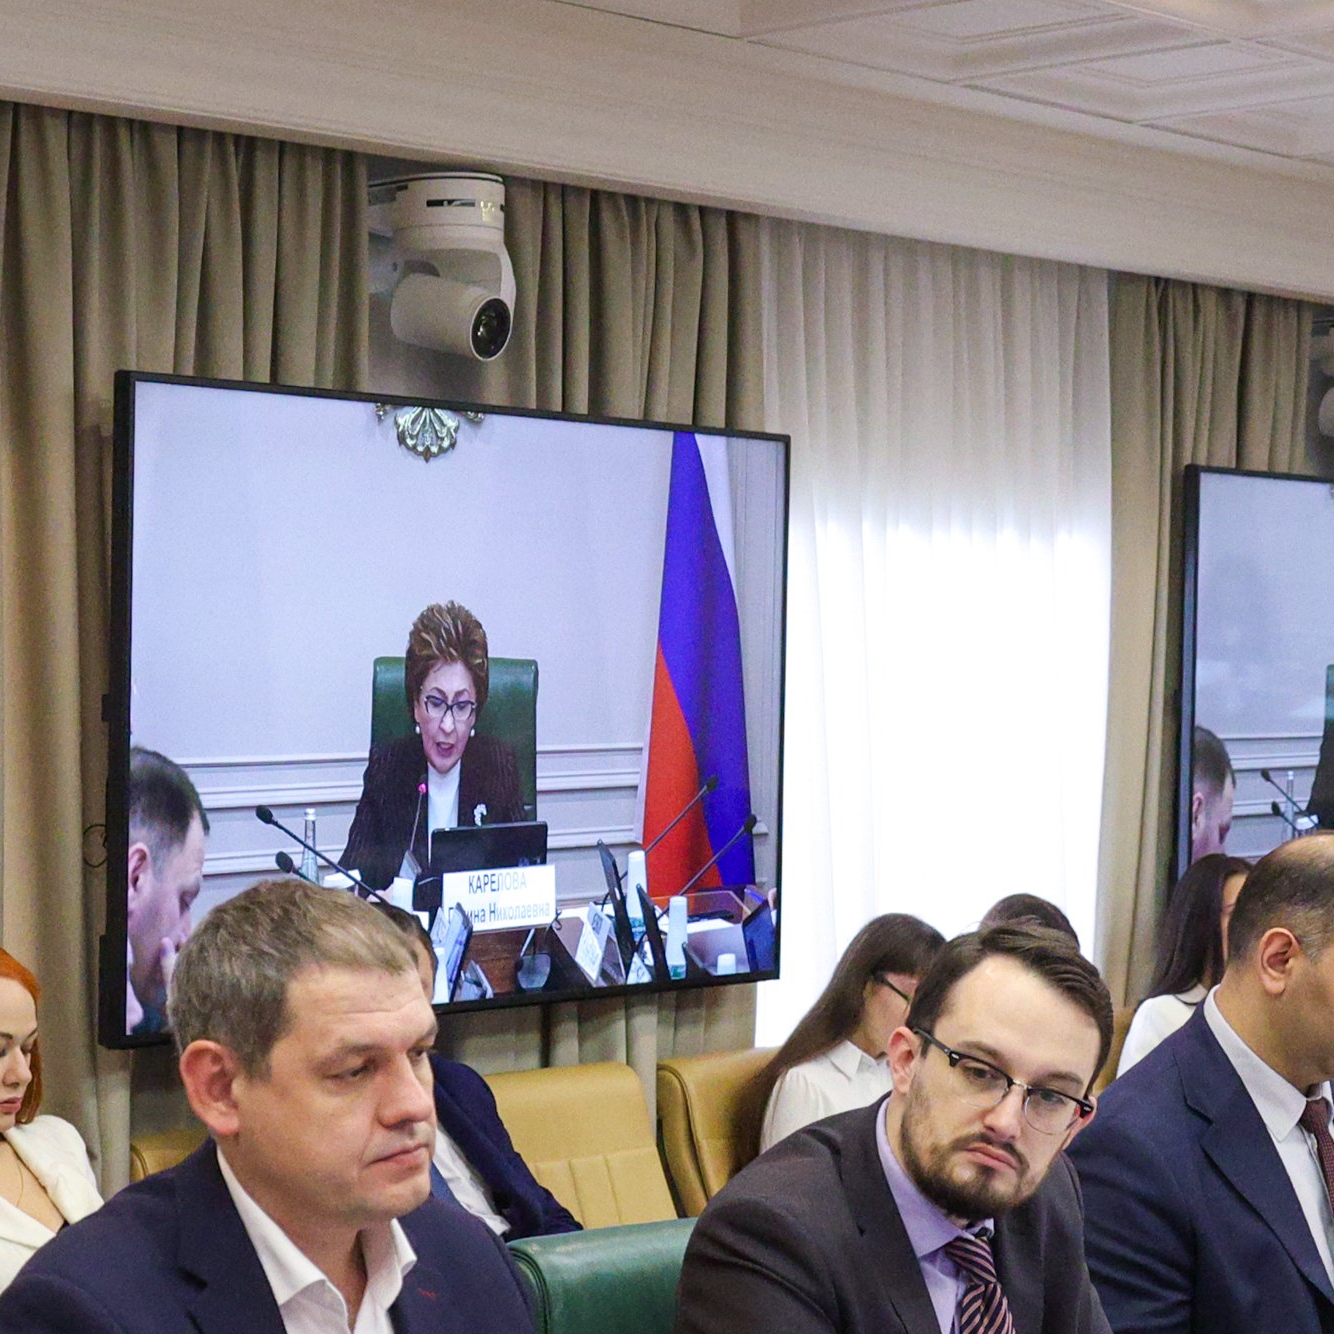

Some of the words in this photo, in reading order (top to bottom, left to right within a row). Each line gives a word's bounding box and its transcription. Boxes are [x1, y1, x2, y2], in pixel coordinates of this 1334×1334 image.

[468, 872, 527, 894] КАРЕЛОВА
[449, 907, 485, 924] Гина
[489, 902, 550, 923] Николаевна
